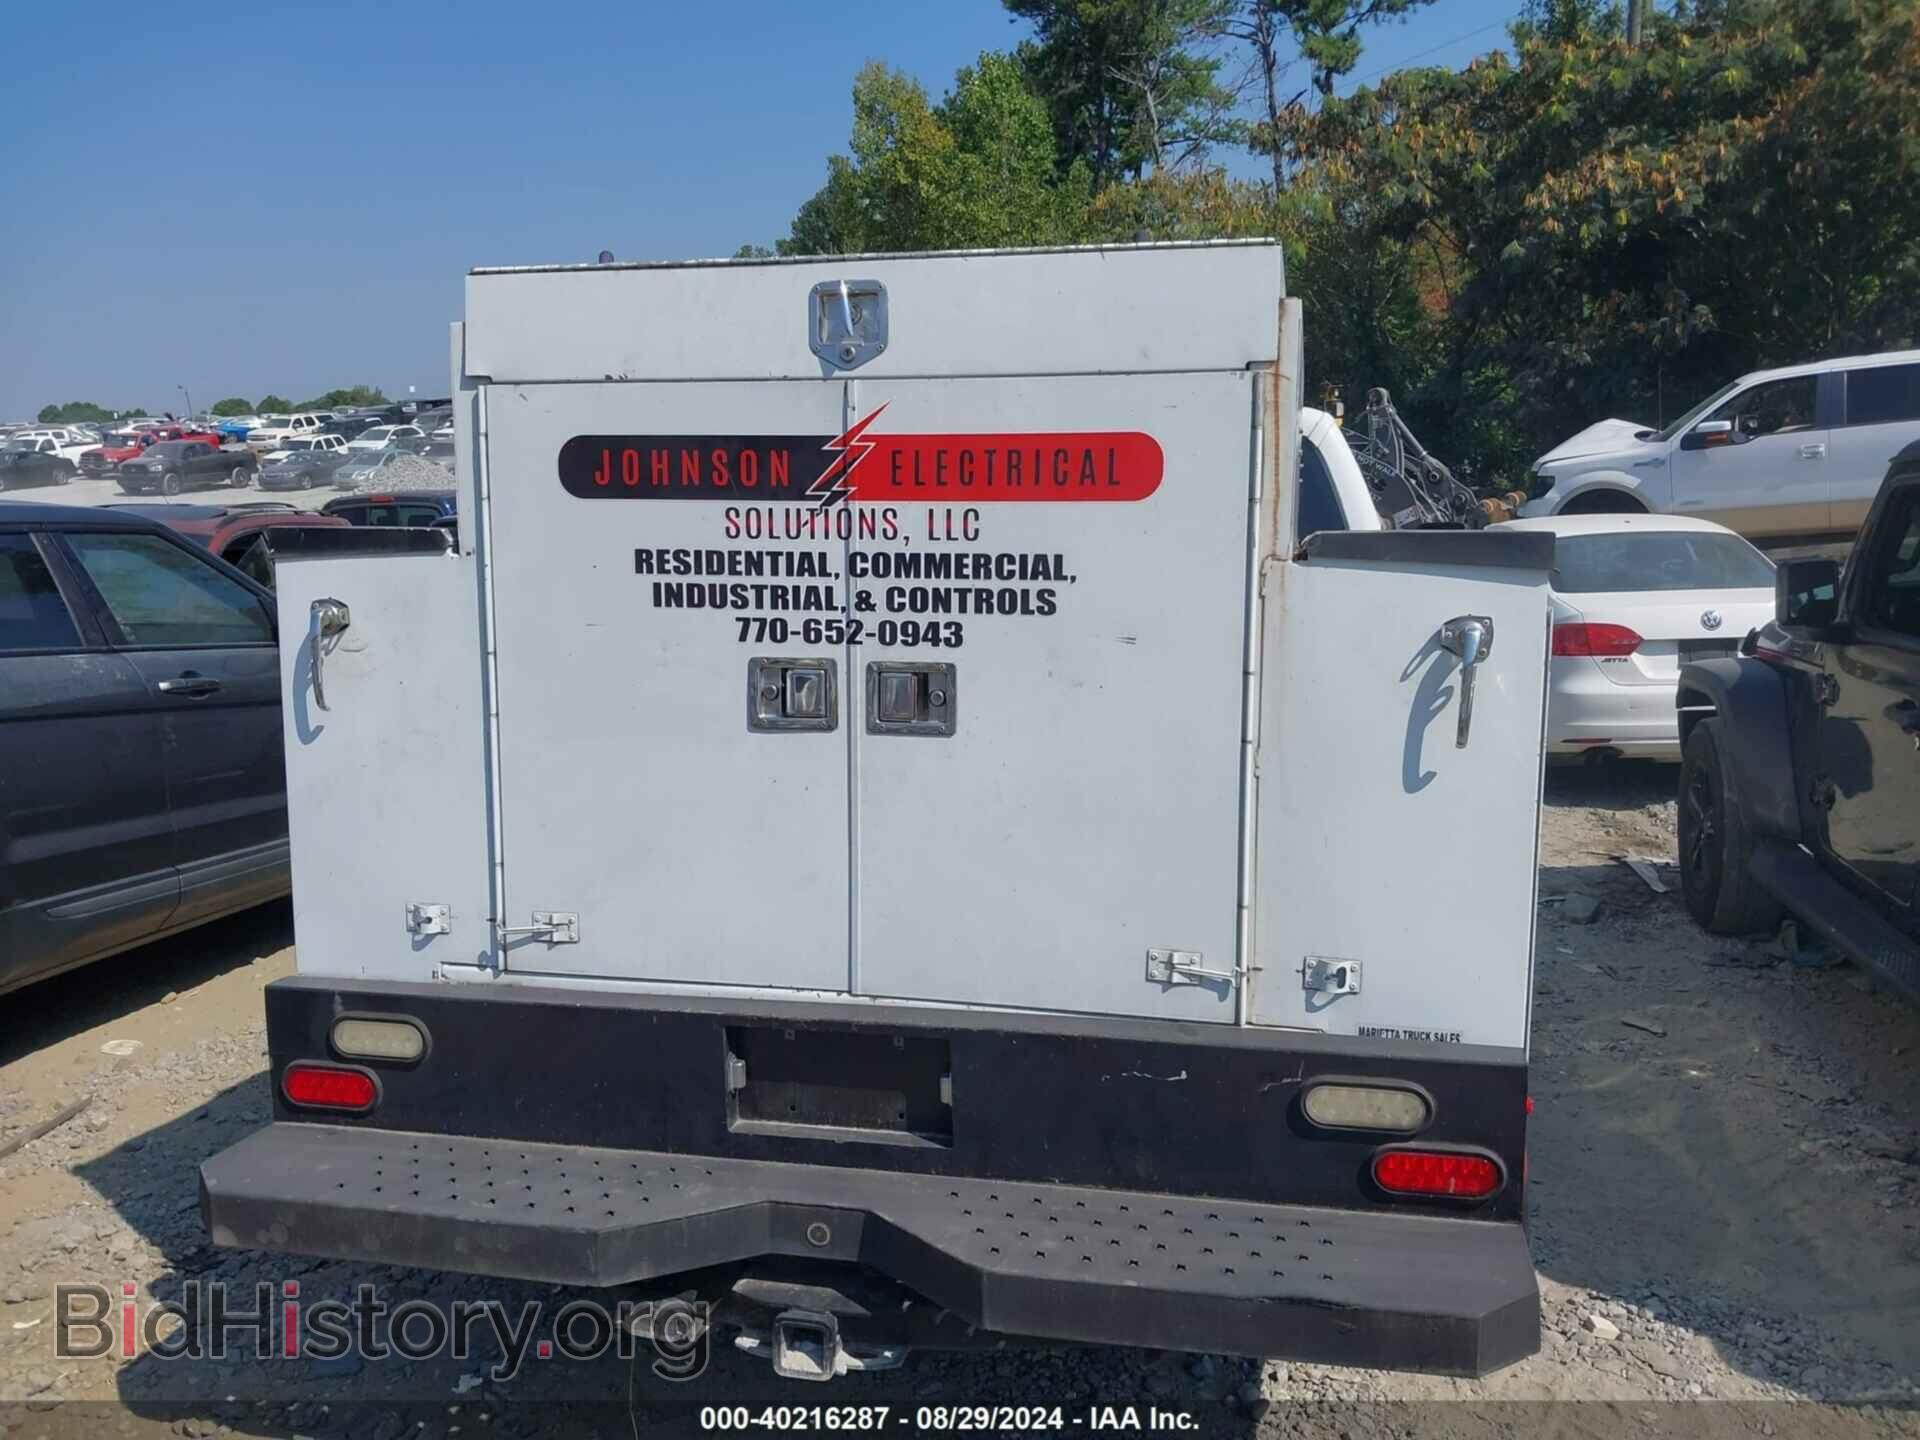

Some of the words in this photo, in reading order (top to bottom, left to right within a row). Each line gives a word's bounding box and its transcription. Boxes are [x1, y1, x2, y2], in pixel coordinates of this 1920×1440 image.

[594, 448, 790, 487] JOHNSON
[890, 447, 1121, 487] ELECTRICAL
[724, 506, 910, 546] SOLUTIONS,
[928, 508, 980, 541] LLC
[634, 548, 840, 581] RESIDENTIAL,
[848, 551, 1077, 584] COMMERCIAL,
[652, 582, 846, 614] INDUSTRIAL,
[854, 589, 877, 612] &
[885, 586, 1057, 615] CONTROLS
[735, 616, 964, 648] 770-652-0943
[1402, 1029, 1431, 1041] TRUCK
